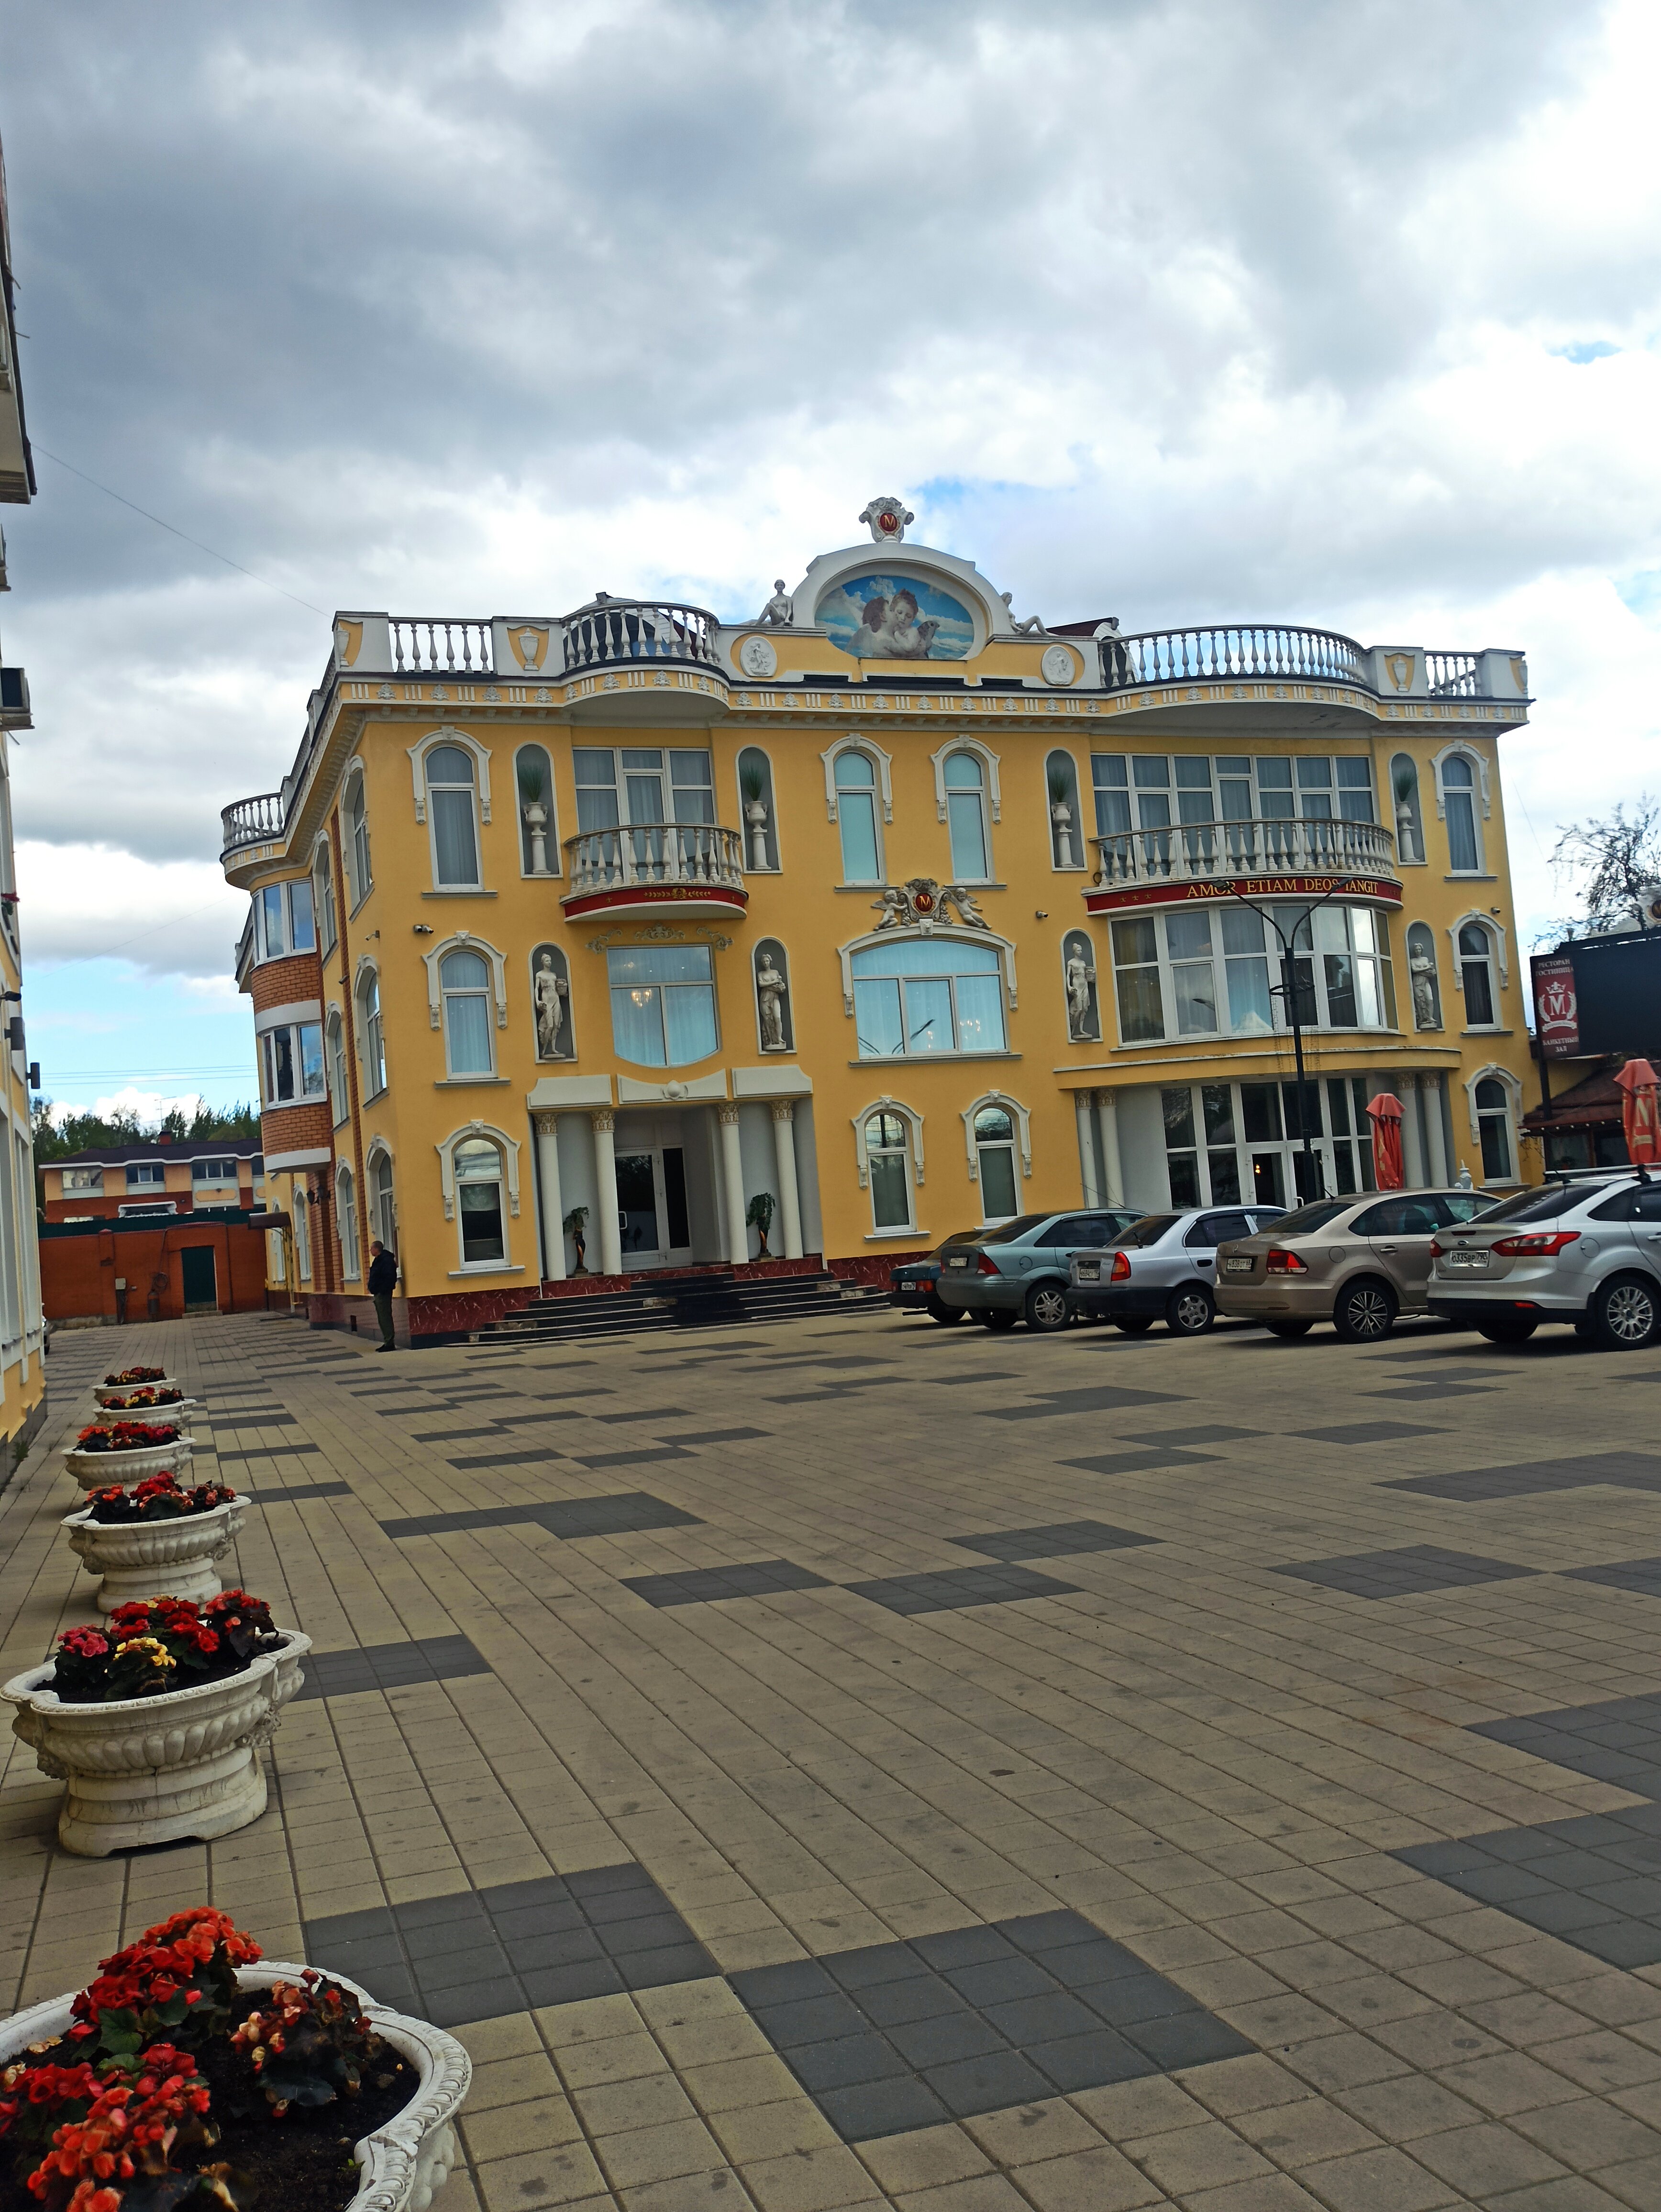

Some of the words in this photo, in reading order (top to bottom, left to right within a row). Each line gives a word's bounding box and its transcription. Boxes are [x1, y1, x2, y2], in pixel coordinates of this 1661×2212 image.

[884, 515, 895, 527] M
[1246, 879, 1297, 893] ETIAM
[919, 896, 931, 908] M
[1548, 994, 1567, 1016] M
